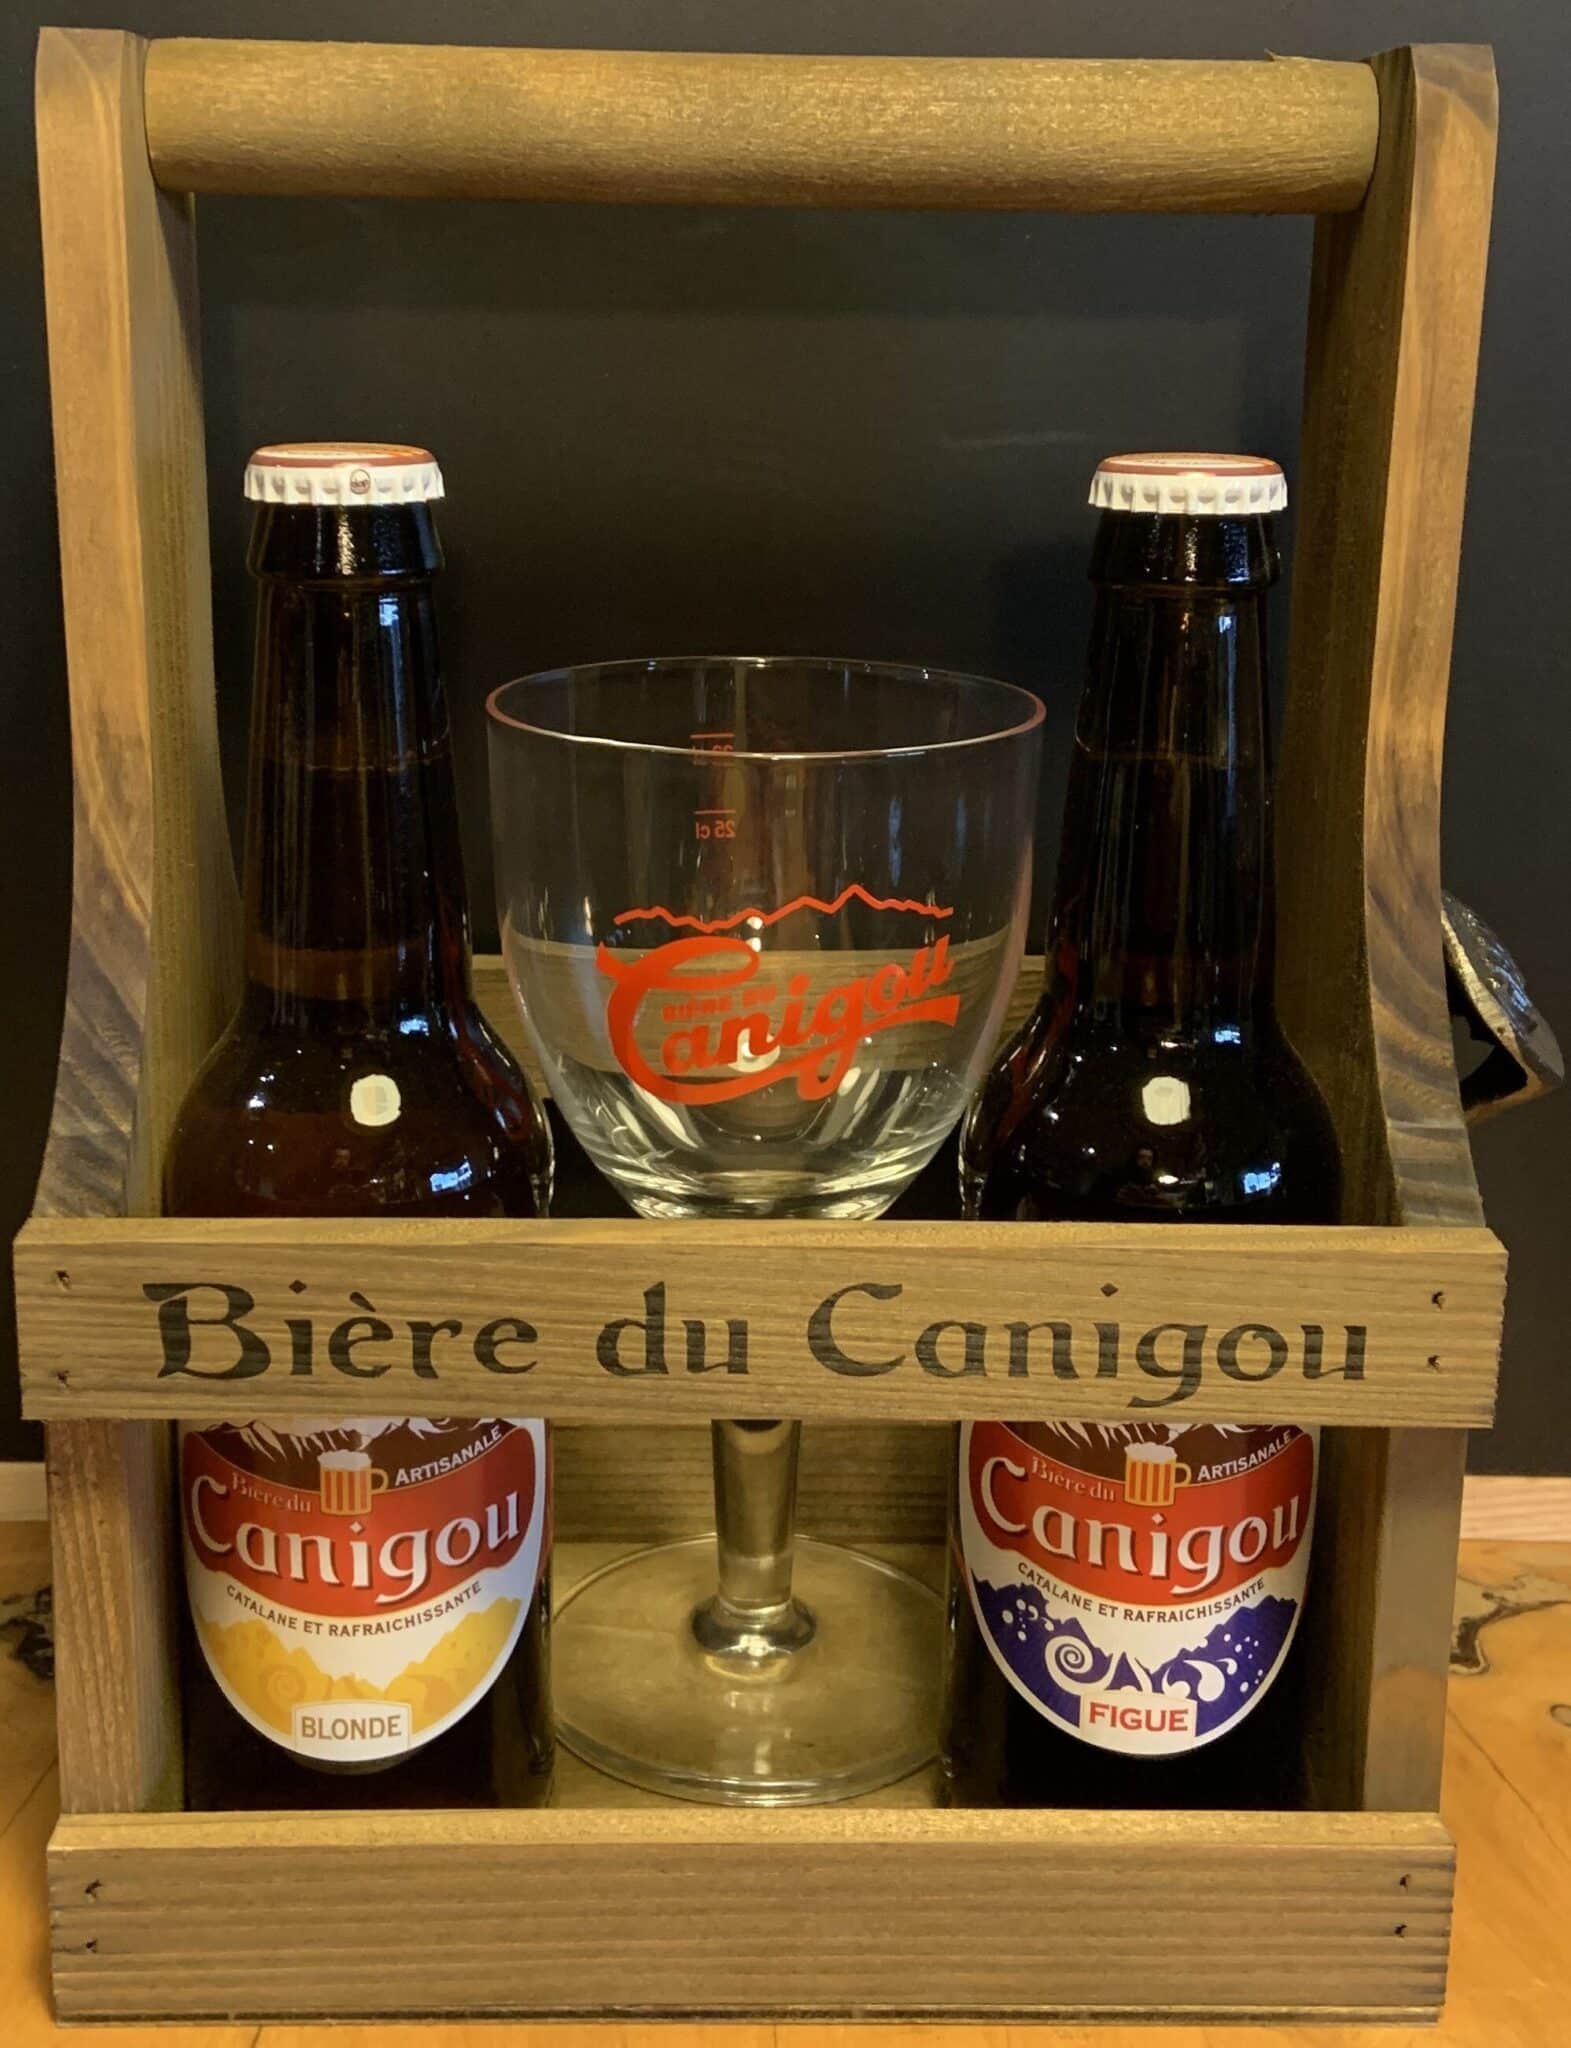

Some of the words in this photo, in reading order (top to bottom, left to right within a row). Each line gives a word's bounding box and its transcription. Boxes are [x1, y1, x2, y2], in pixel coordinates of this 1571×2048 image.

[595, 933, 961, 1104] Canigou
[143, 1280, 539, 1380] Bière
[596, 1281, 750, 1376] du
[807, 1282, 1368, 1408] Canigou
[395, 1424, 503, 1487] ARTISANALE
[1197, 1429, 1292, 1481] ARTISANALE
[287, 1492, 313, 1513] du
[1089, 1480, 1116, 1502] du
[191, 1474, 520, 1605] Canigou
[980, 1456, 1299, 1595] Canigou
[226, 1584, 297, 1630] CATALANE
[303, 1621, 323, 1635] ET
[329, 1580, 482, 1637] RAFRAICHISSANTE
[1018, 1561, 1092, 1612] CATALANE
[1098, 1603, 1119, 1618] ET
[1123, 1577, 1265, 1623] RAFRAICHISSANTE
[300, 1715, 403, 1741] BLONDE
[1088, 1701, 1189, 1733] FIGUE
